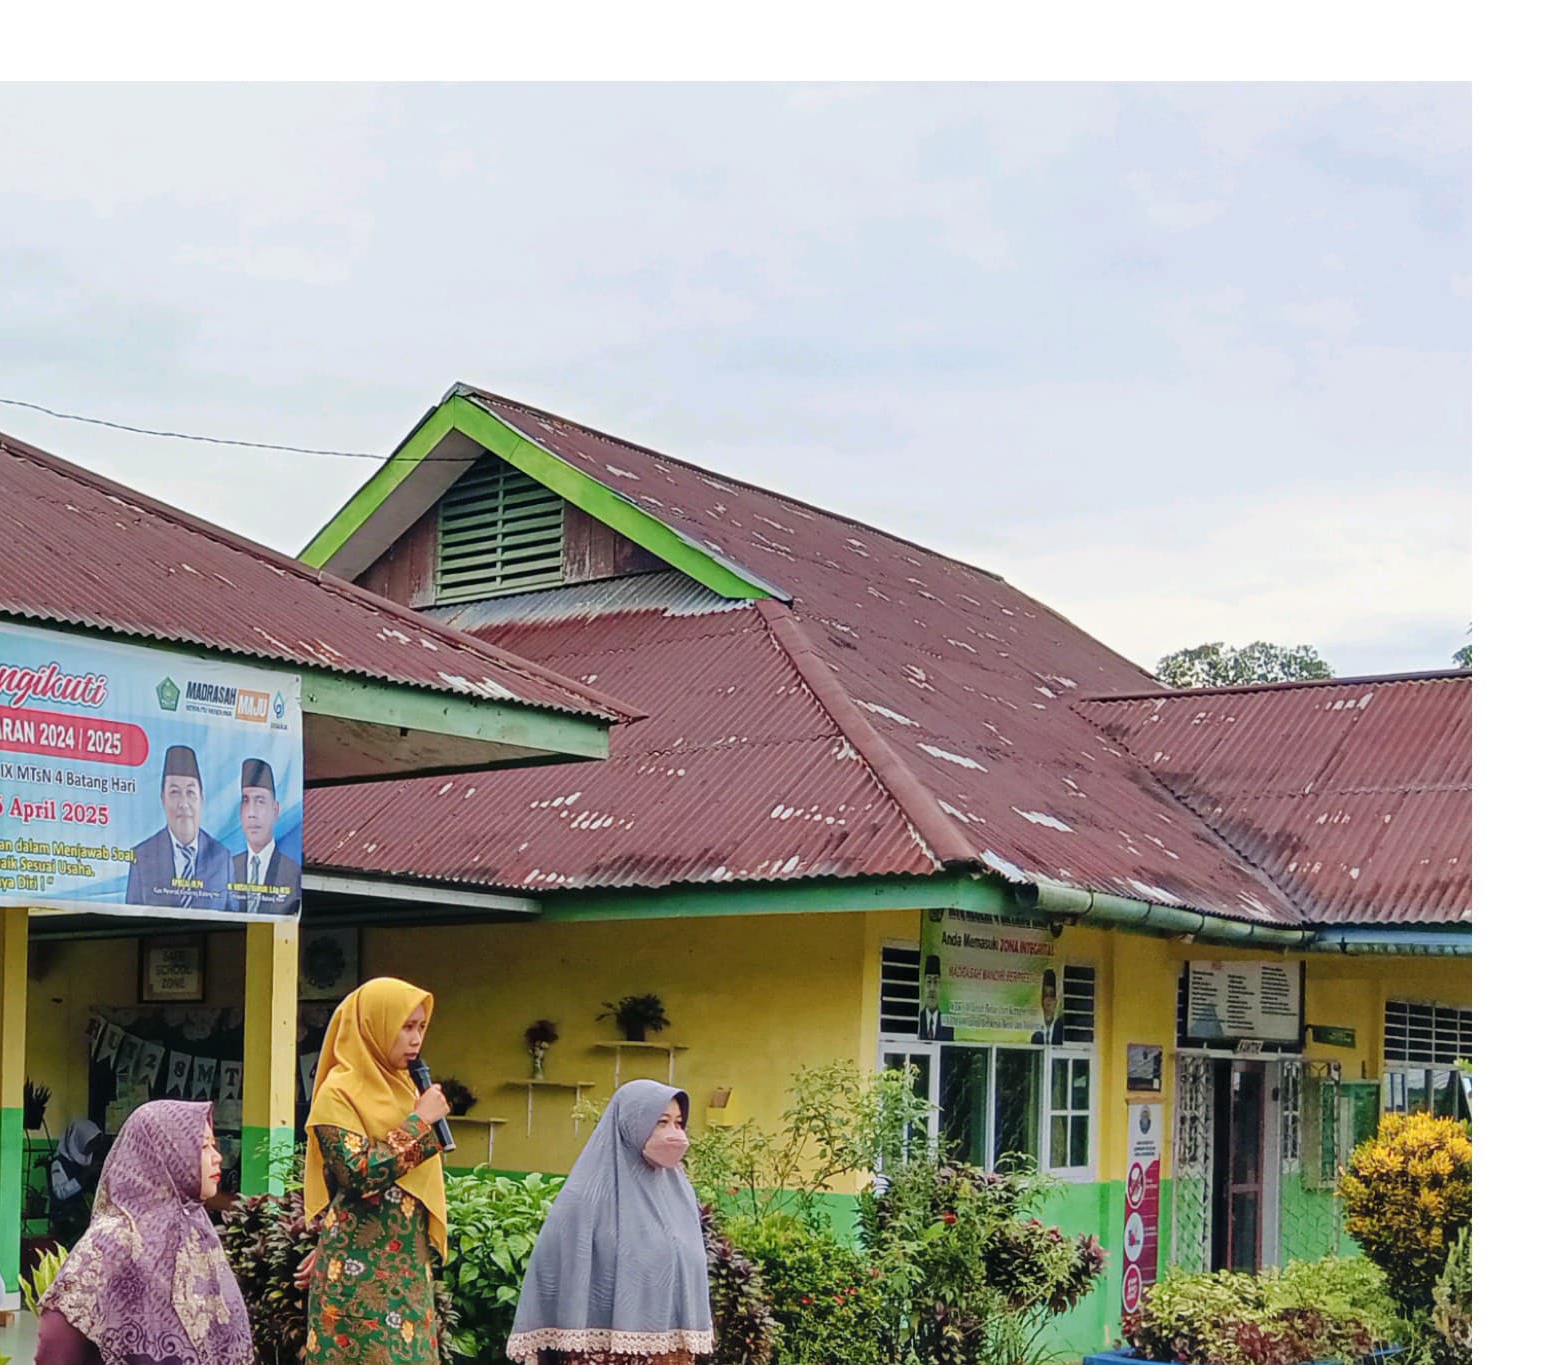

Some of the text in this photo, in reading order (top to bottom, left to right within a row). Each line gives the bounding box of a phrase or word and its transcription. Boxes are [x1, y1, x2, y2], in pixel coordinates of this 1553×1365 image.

[185, 681, 267, 717] MADRASAH MAJU
[40, 723, 74, 749] 2024
[87, 729, 122, 755] 2025
[0, 764, 13, 780] IX
[17, 766, 51, 784] MTsN
[55, 769, 63, 785] 4
[66, 771, 108, 793] Batang
[111, 778, 136, 793] Hari
[9, 797, 56, 824] April
[62, 802, 110, 826] 2025
[15, 837, 50, 854] dalam
[52, 843, 110, 862] Menjawab
[111, 848, 137, 864] Soal,
[20, 856, 56, 873] Sesuai
[17, 874, 38, 889] Diri
[942, 931, 962, 946] Anda
